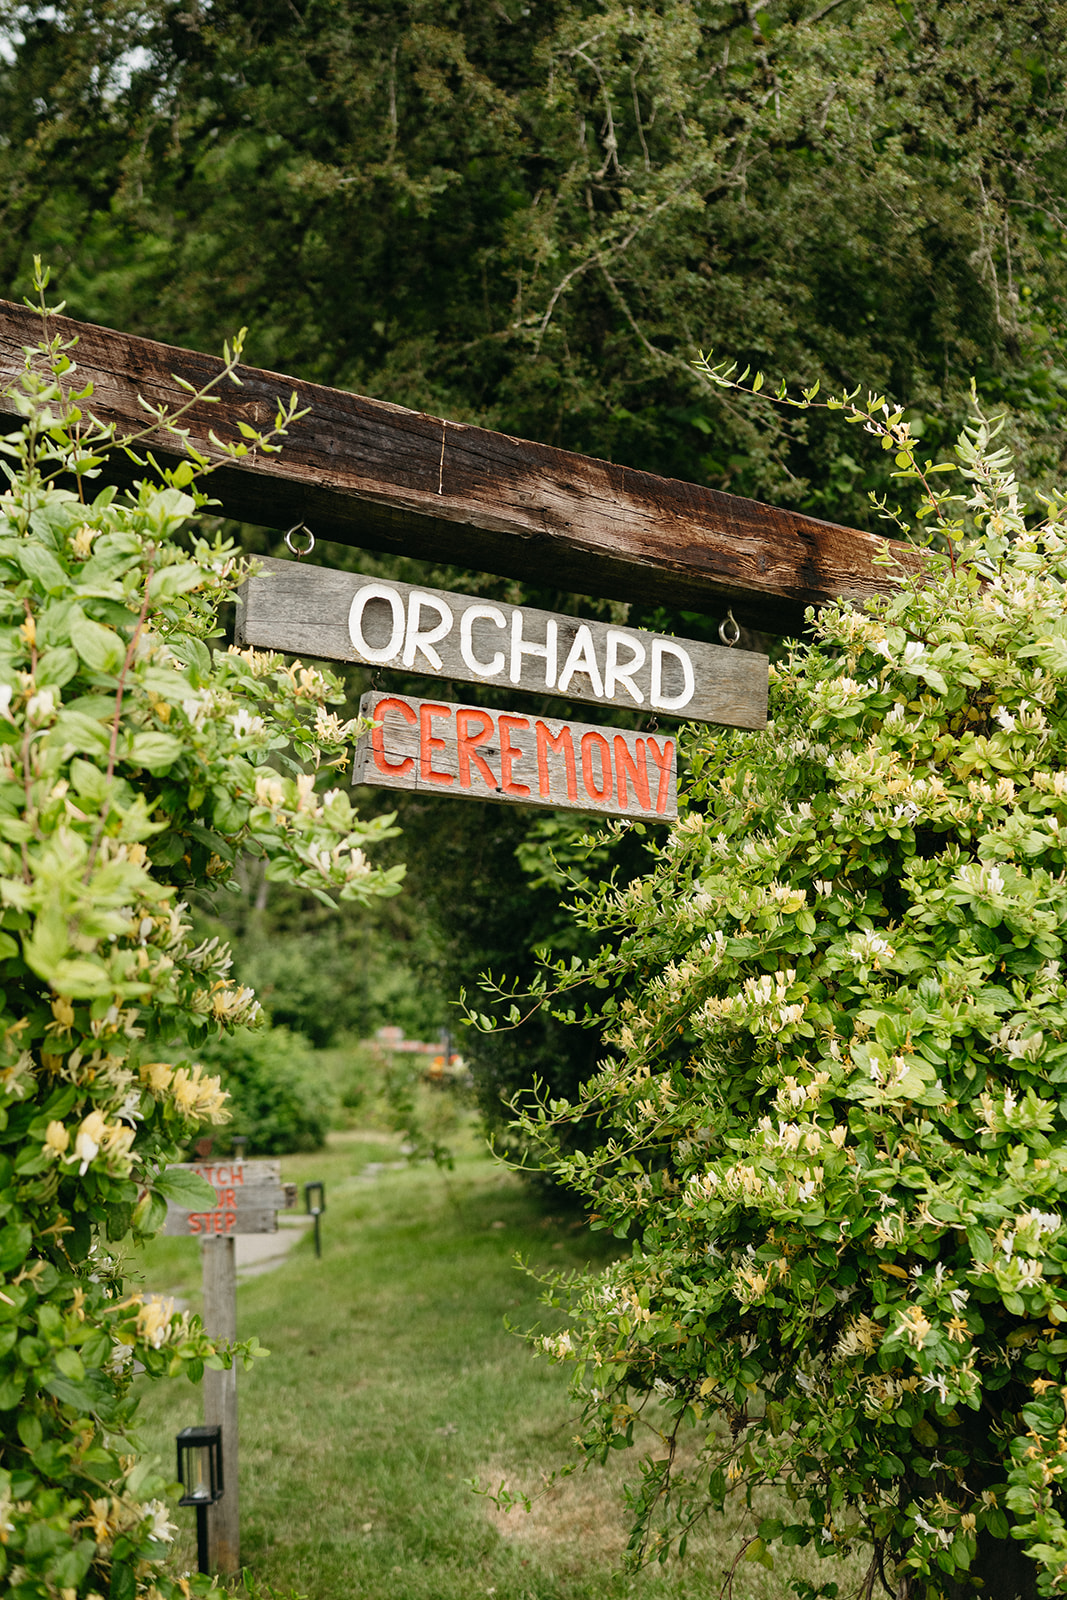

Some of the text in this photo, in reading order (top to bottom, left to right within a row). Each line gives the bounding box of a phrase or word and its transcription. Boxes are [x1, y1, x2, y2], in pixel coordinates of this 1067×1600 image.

[348, 583, 696, 710] ORCHARD
[372, 697, 674, 815] CEREMONY
[187, 1212, 237, 1234] STEP
[210, 1188, 238, 1210] UR
